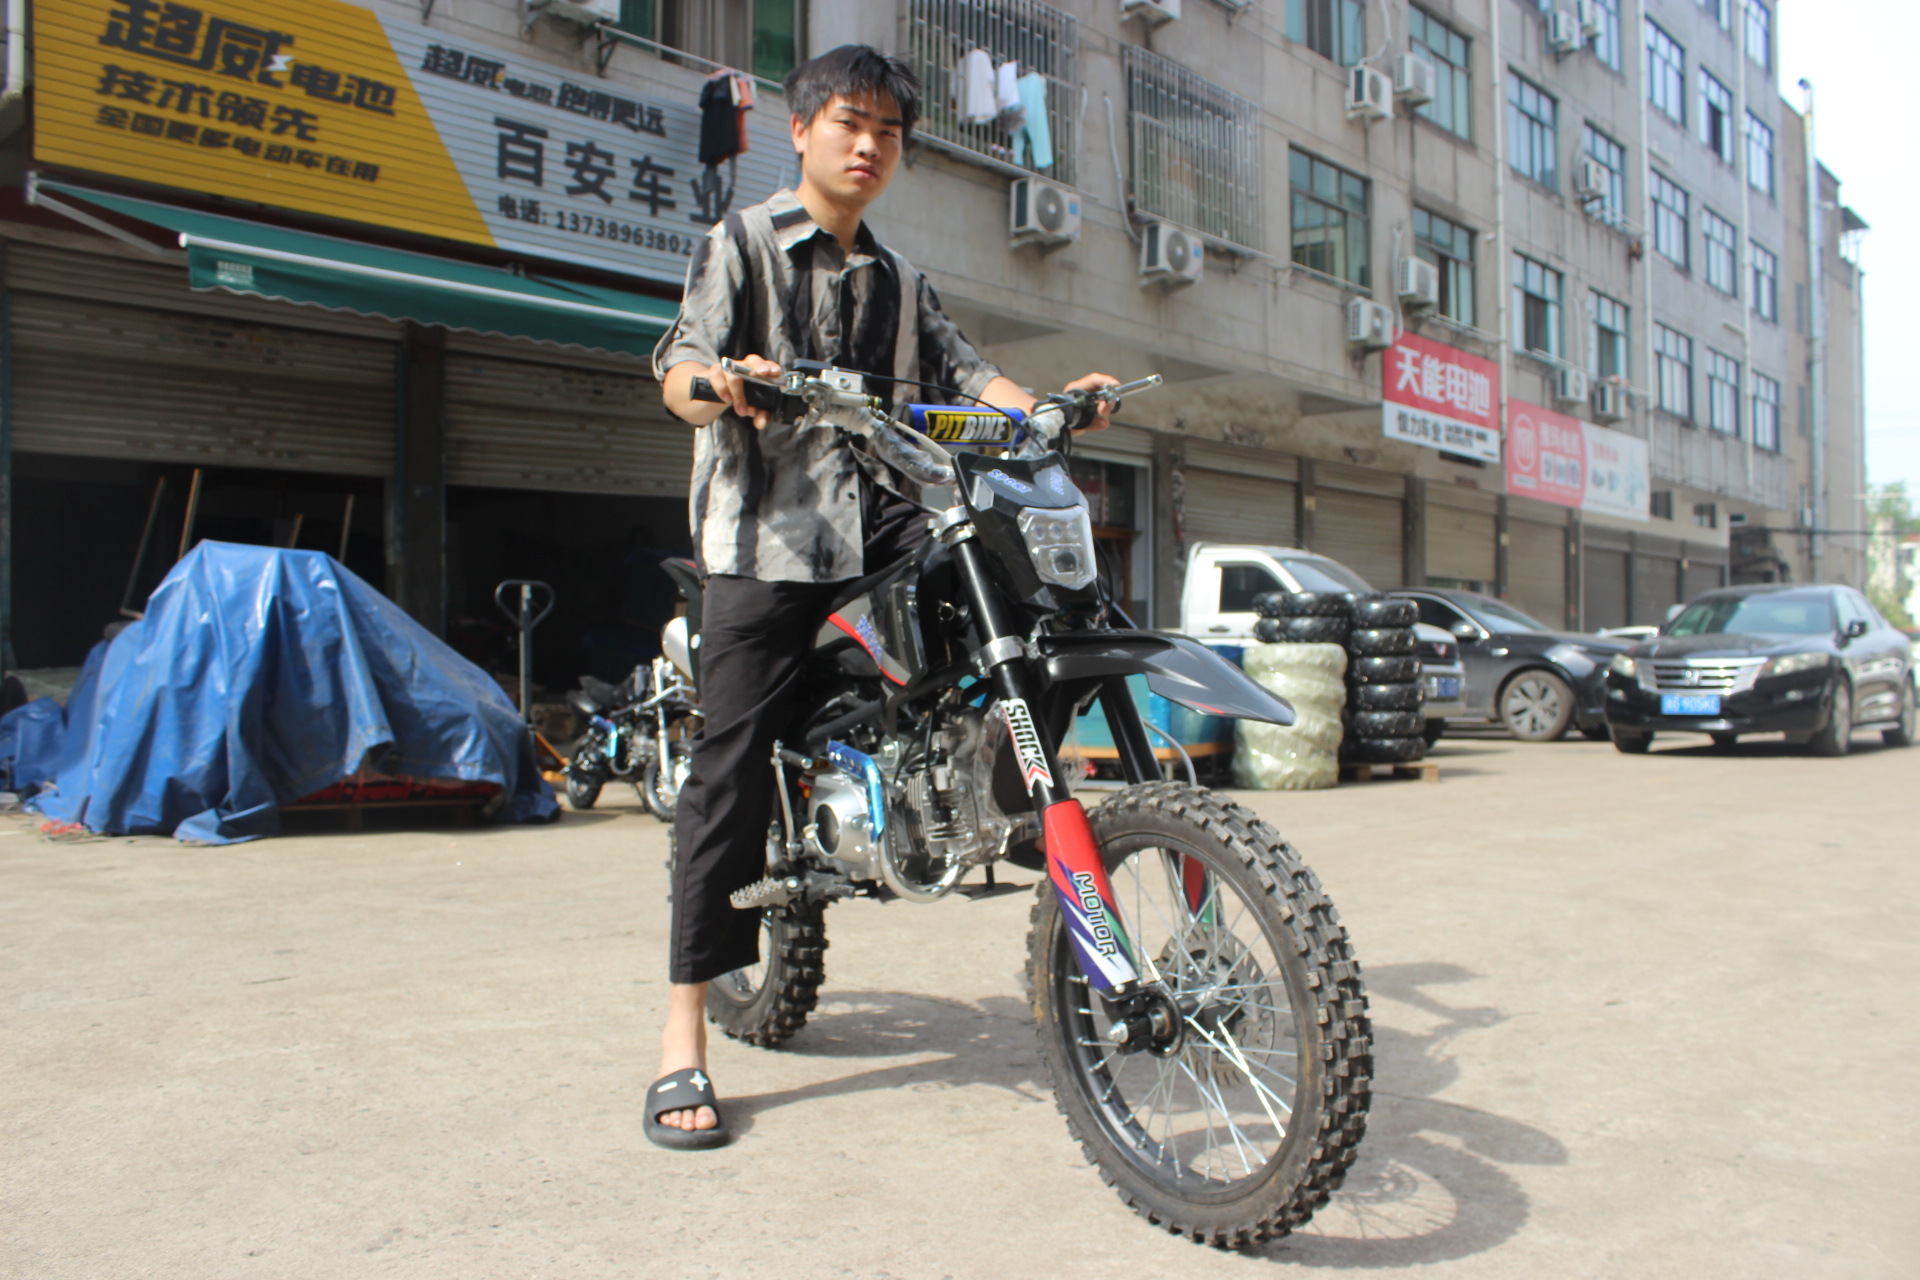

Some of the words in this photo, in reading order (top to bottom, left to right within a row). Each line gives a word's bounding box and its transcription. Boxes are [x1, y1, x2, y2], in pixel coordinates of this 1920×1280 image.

[95, 64, 319, 142] 技术领先
[94, 105, 381, 182] 全国更多电动车在用
[493, 115, 737, 225] 百安车业
[1395, 344, 1491, 418] 天能电池
[986, 468, 1033, 493] SPORT
[1006, 704, 1047, 772] SHOCK
[1072, 870, 1119, 959] MOTOR
